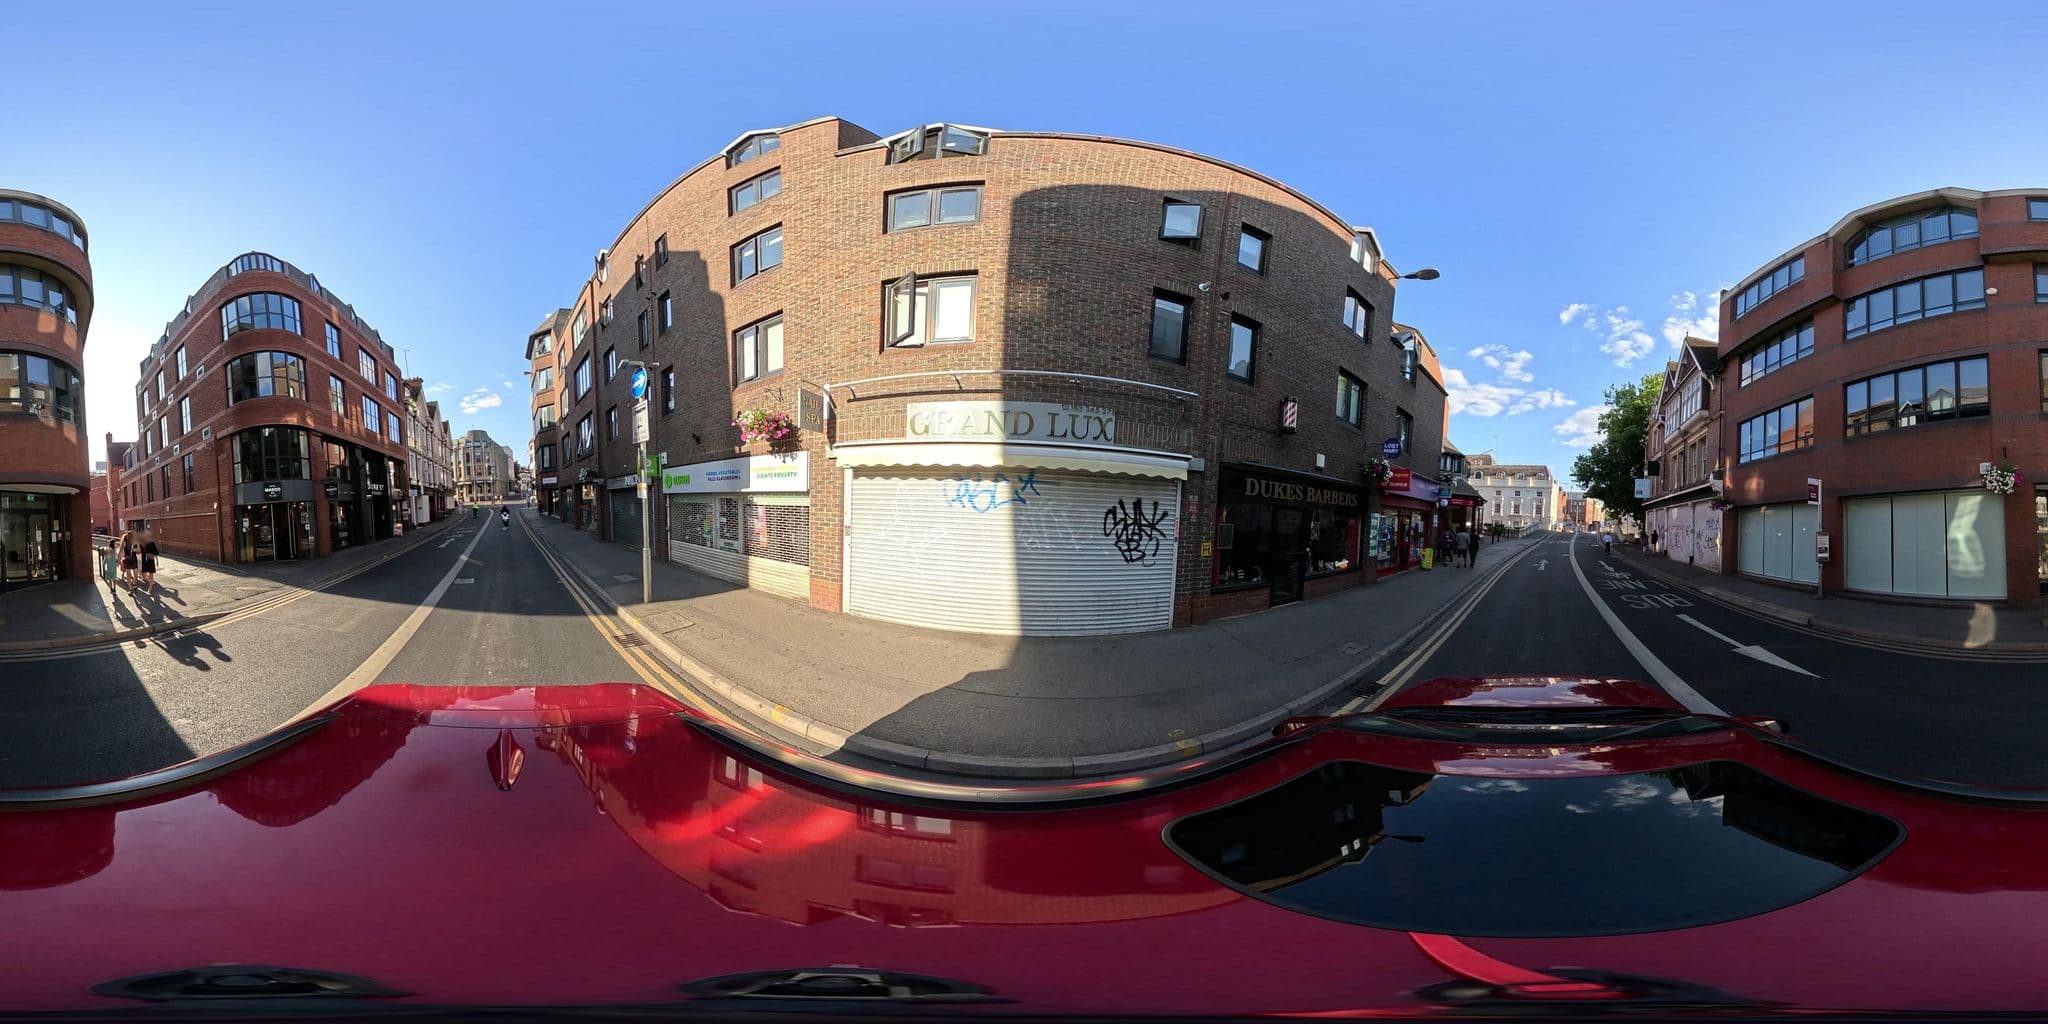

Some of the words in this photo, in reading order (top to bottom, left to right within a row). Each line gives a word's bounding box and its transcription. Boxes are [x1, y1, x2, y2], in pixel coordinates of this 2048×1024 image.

[805, 413, 820, 425] SPA
[909, 409, 1034, 436] GRAND
[1046, 411, 1113, 442] LUX
[1245, 478, 1304, 501] DUKES
[1306, 487, 1358, 506] BARBERS
[1600, 579, 1670, 590] LANE
[1620, 593, 1695, 609] BUS
